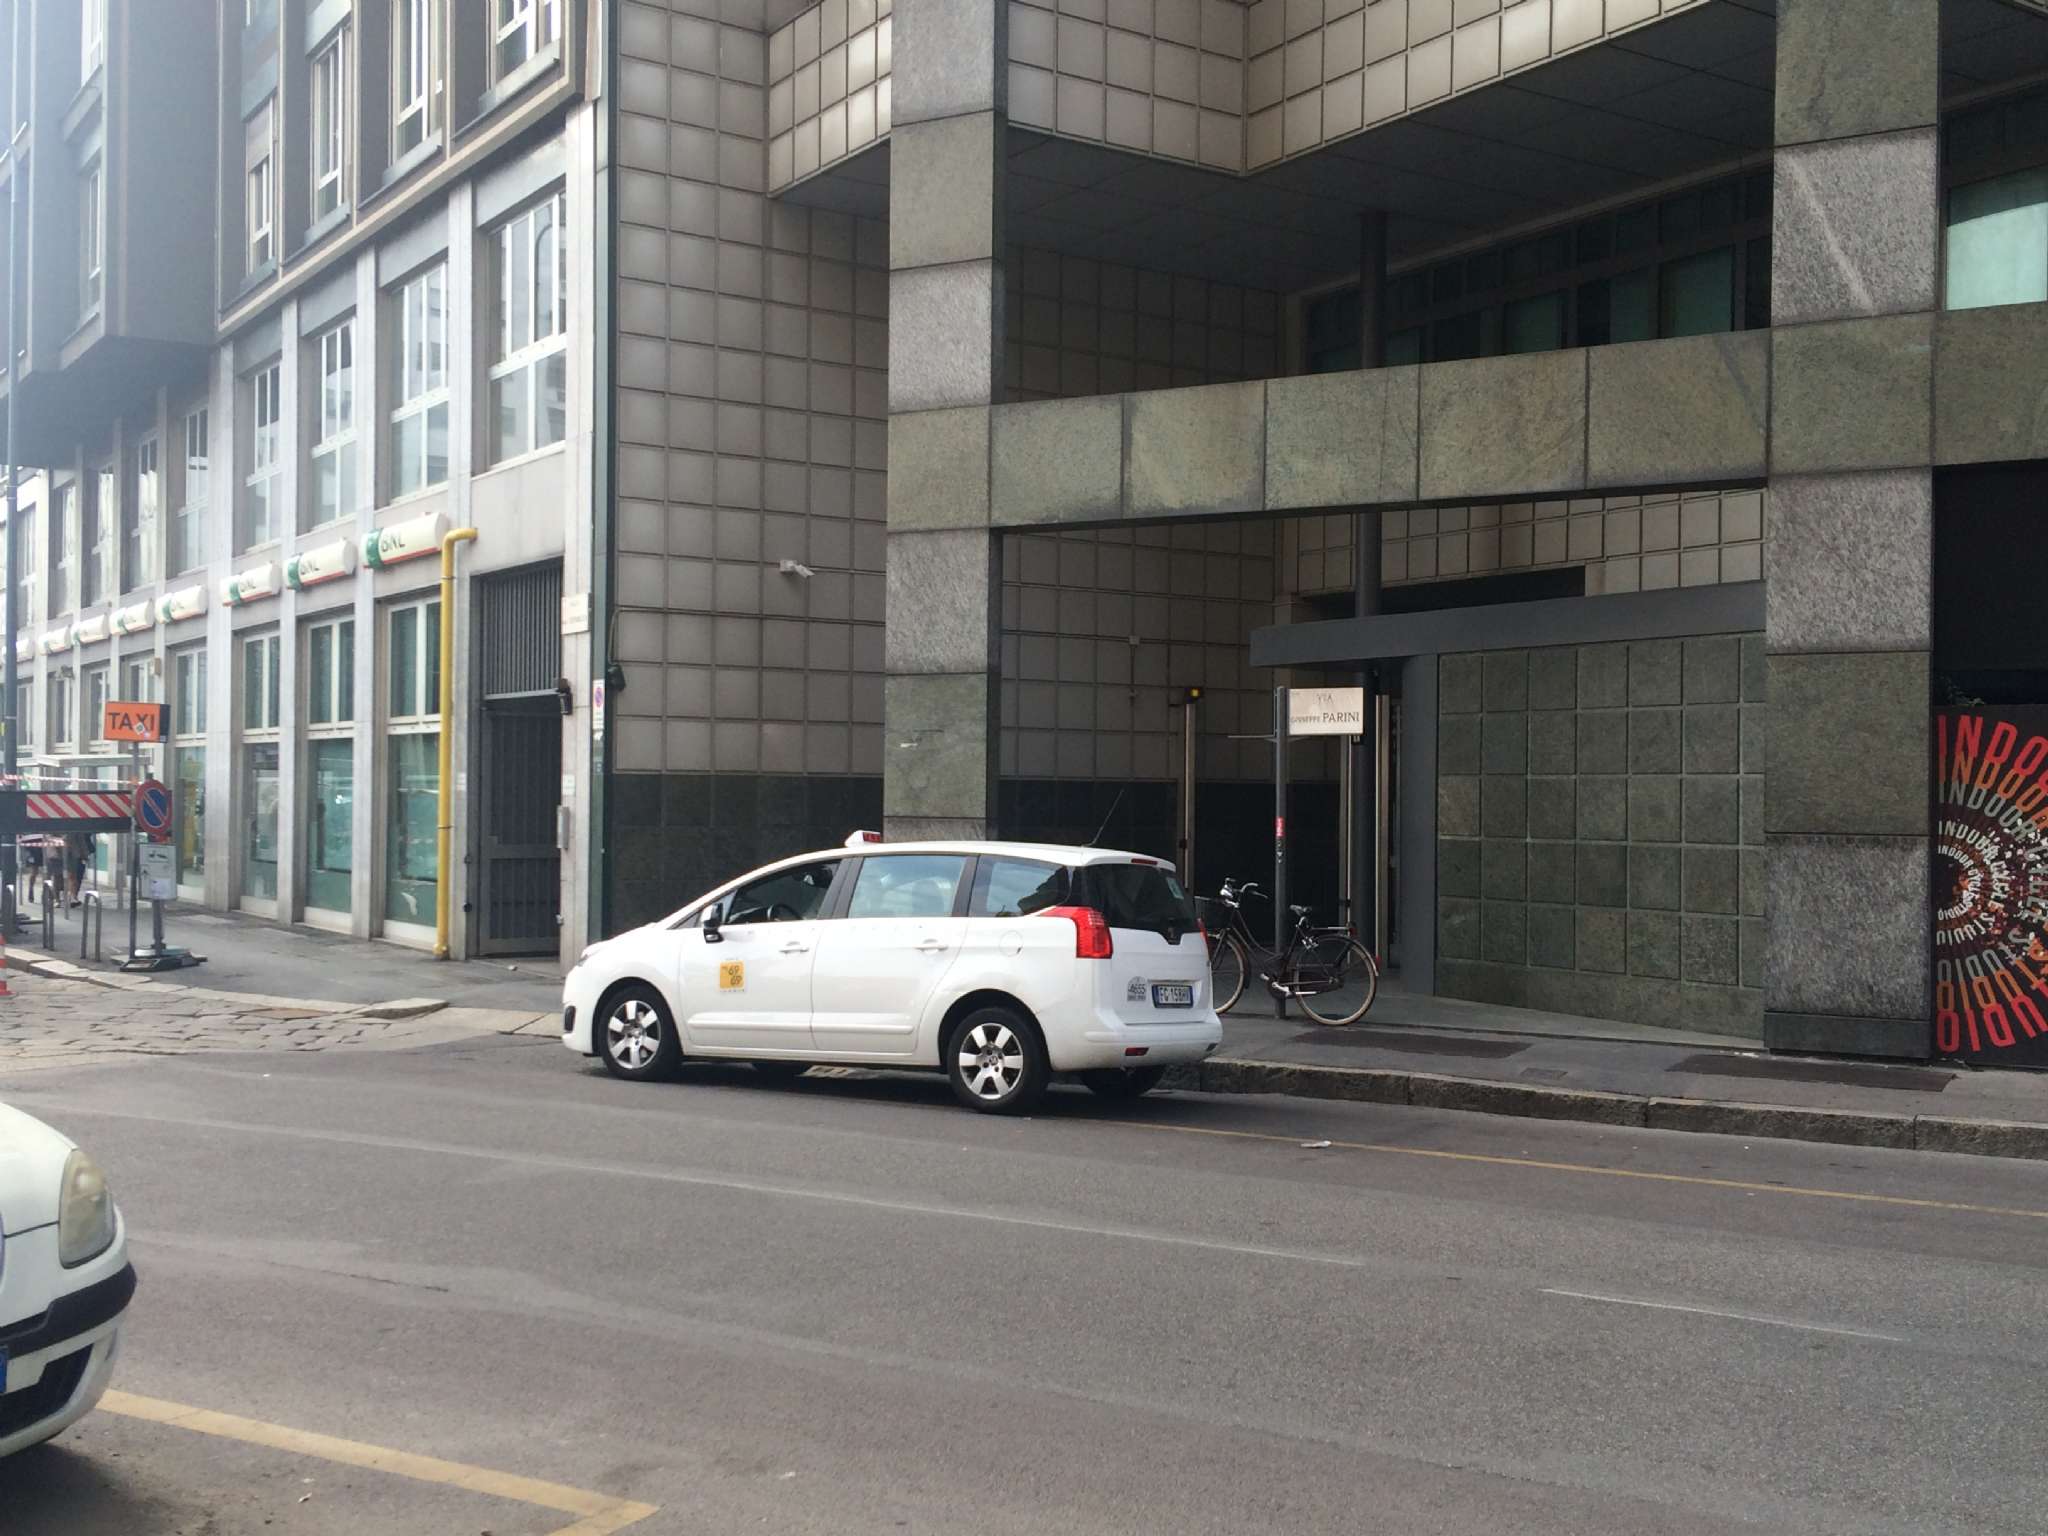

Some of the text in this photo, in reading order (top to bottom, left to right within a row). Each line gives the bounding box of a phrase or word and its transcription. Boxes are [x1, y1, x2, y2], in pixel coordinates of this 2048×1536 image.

[1315, 693, 1334, 705] VIA
[107, 712, 155, 731] TAXI
[1322, 711, 1360, 723] PARINI
